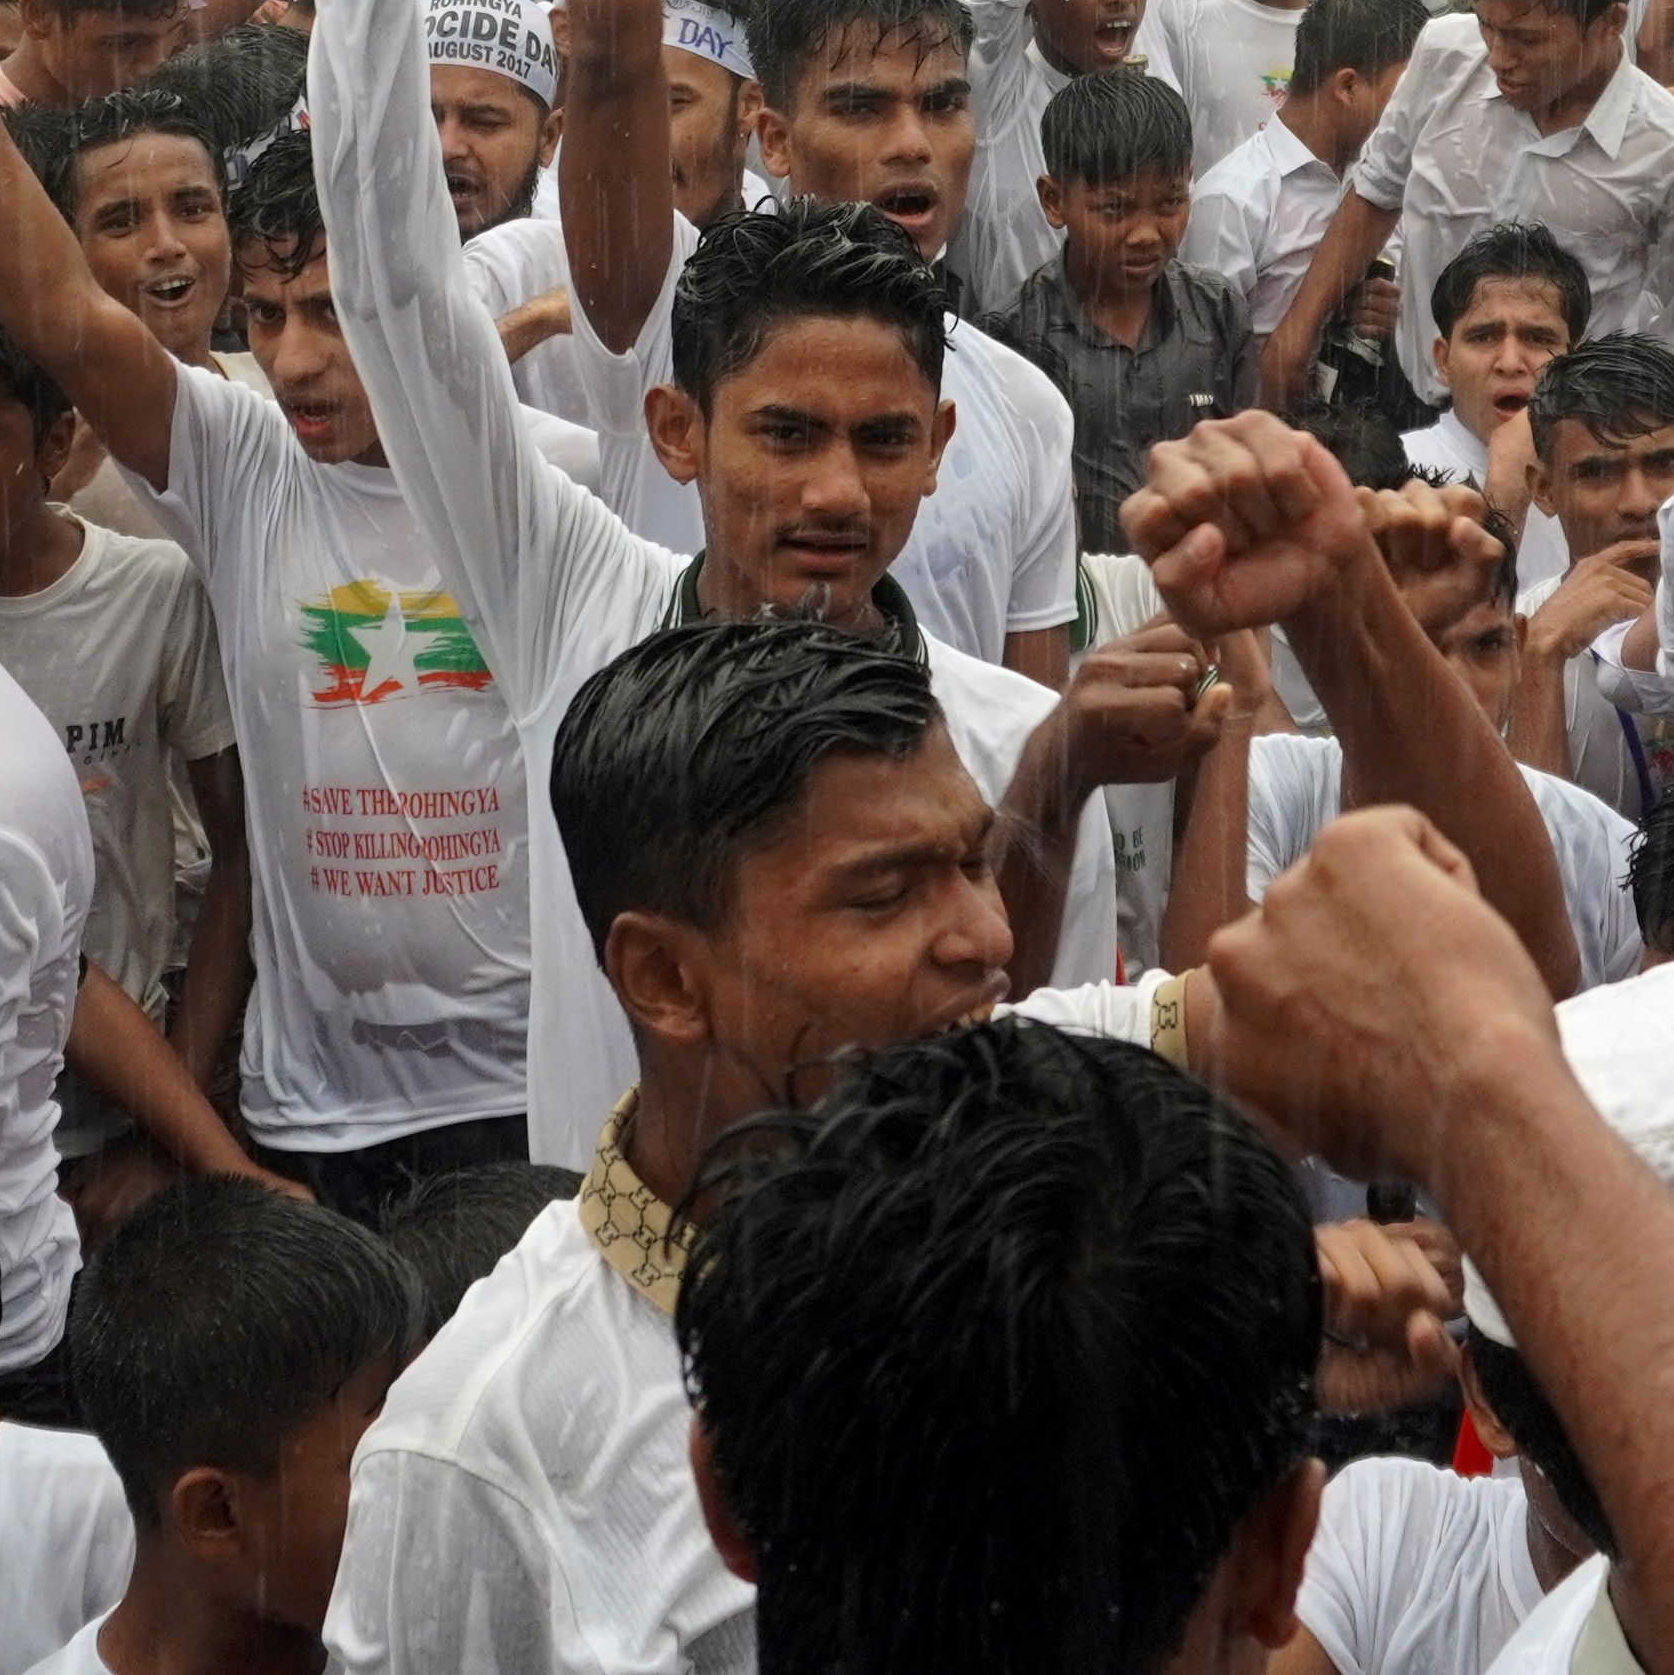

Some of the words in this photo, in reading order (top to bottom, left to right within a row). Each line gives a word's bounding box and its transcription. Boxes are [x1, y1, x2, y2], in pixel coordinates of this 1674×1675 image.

[678, 17, 733, 59] DAY
[496, 49, 532, 80] 2017
[324, 868, 352, 897] WE
[355, 869, 416, 897] WANT
[422, 864, 501, 897] JUSTICE
